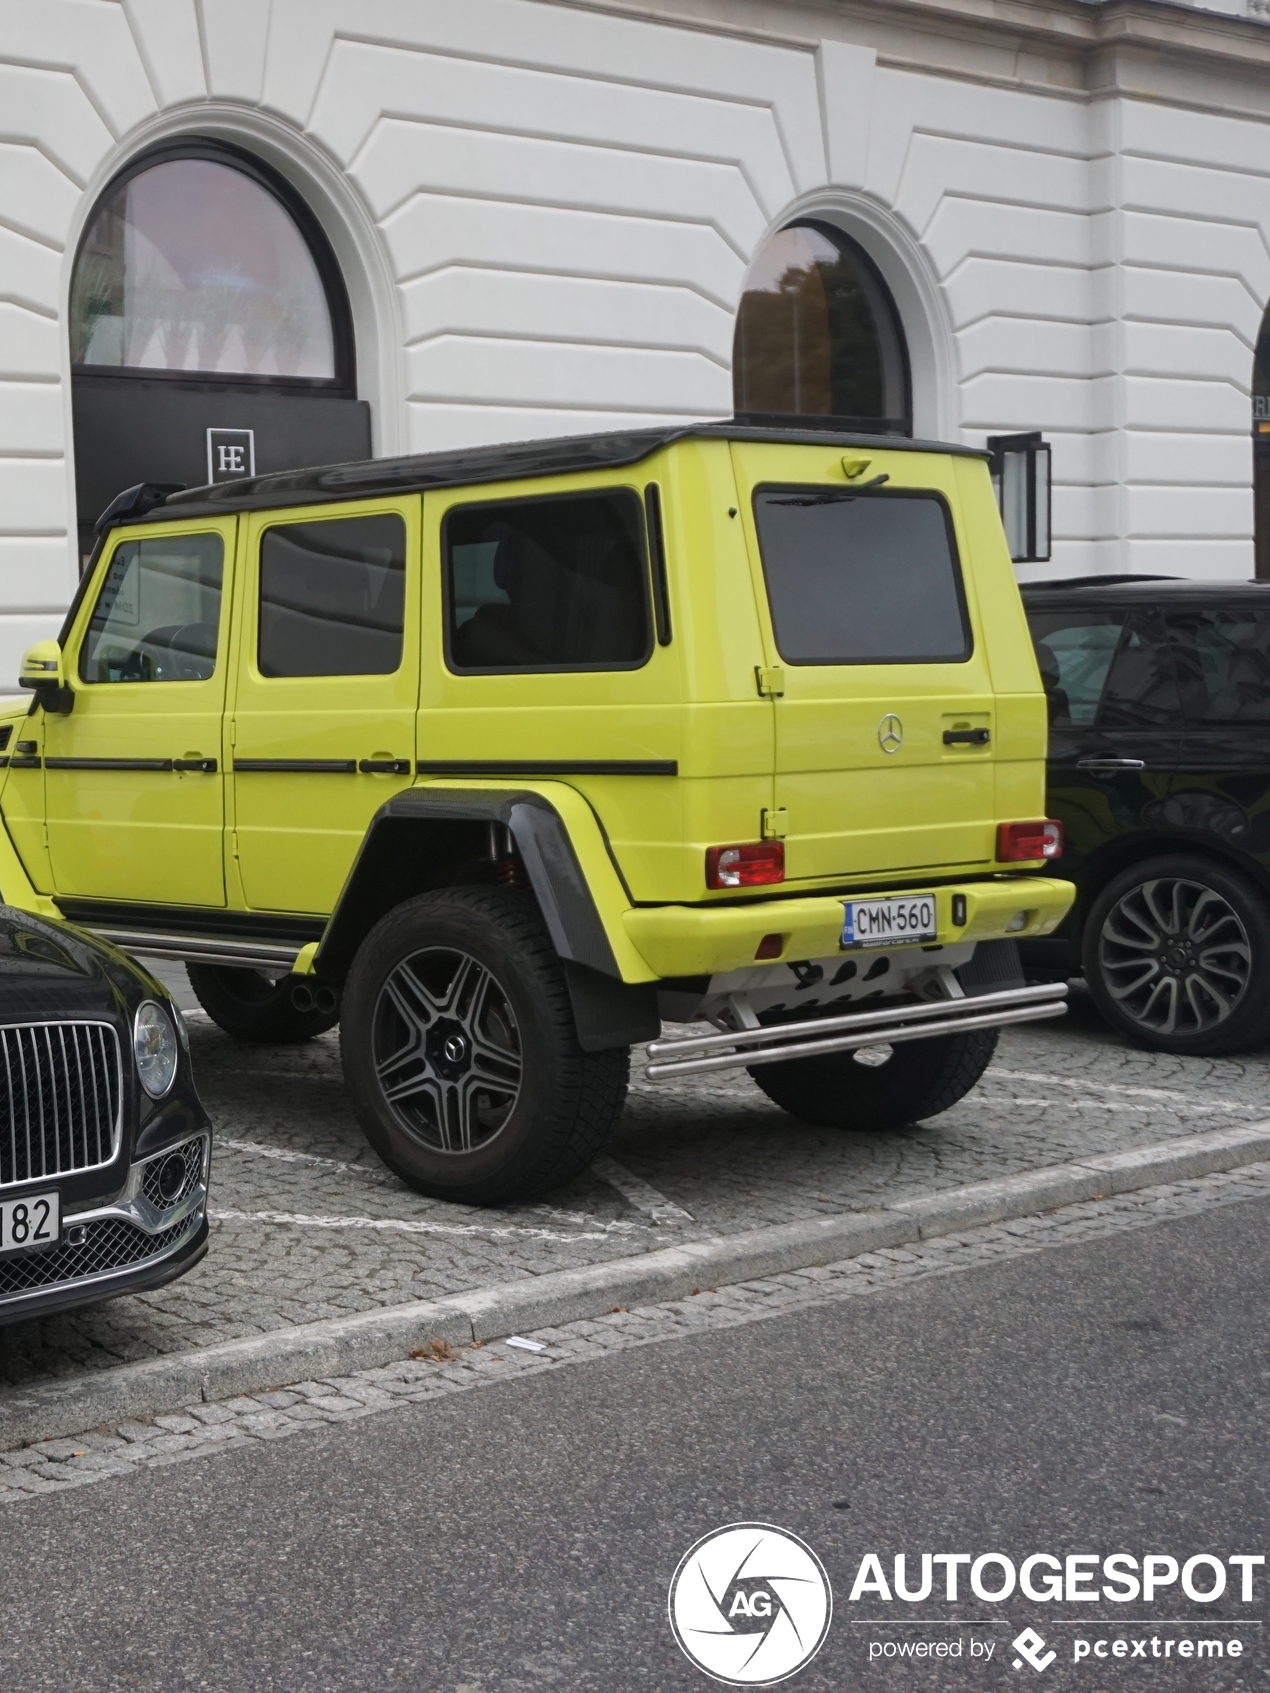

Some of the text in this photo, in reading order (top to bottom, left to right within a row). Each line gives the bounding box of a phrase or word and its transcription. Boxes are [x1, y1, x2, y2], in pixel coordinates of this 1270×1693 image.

[217, 445, 245, 471] HE
[844, 926, 854, 934] FIN
[857, 902, 930, 934] CMN-560
